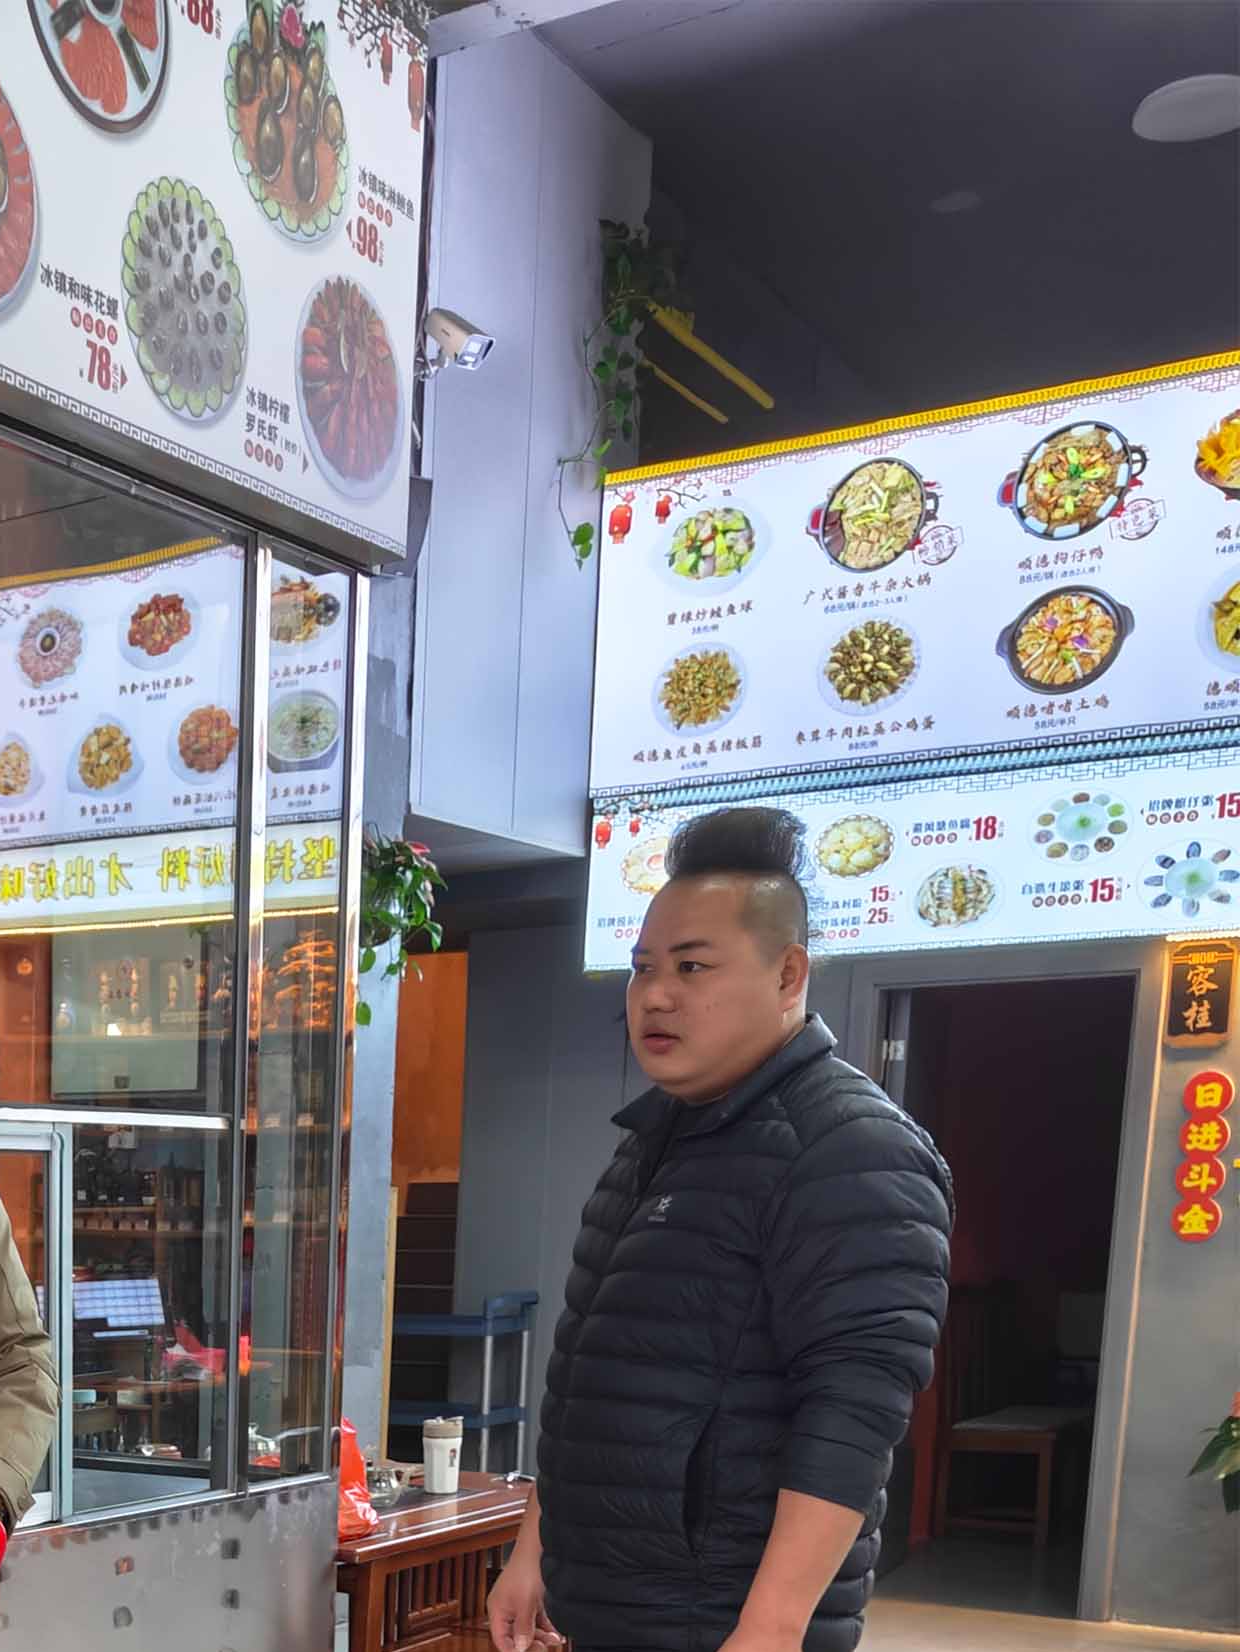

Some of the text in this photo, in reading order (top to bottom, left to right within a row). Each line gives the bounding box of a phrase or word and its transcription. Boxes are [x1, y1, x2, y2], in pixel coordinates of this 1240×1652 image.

[1215, 791, 1240, 820] 15
[973, 815, 998, 841] 18
[870, 885, 890, 903] 15
[1088, 877, 1115, 903] 15
[867, 907, 889, 925] 25
[1182, 965, 1219, 1032] 容桂
[1177, 1082, 1224, 1236] 日进斗金
